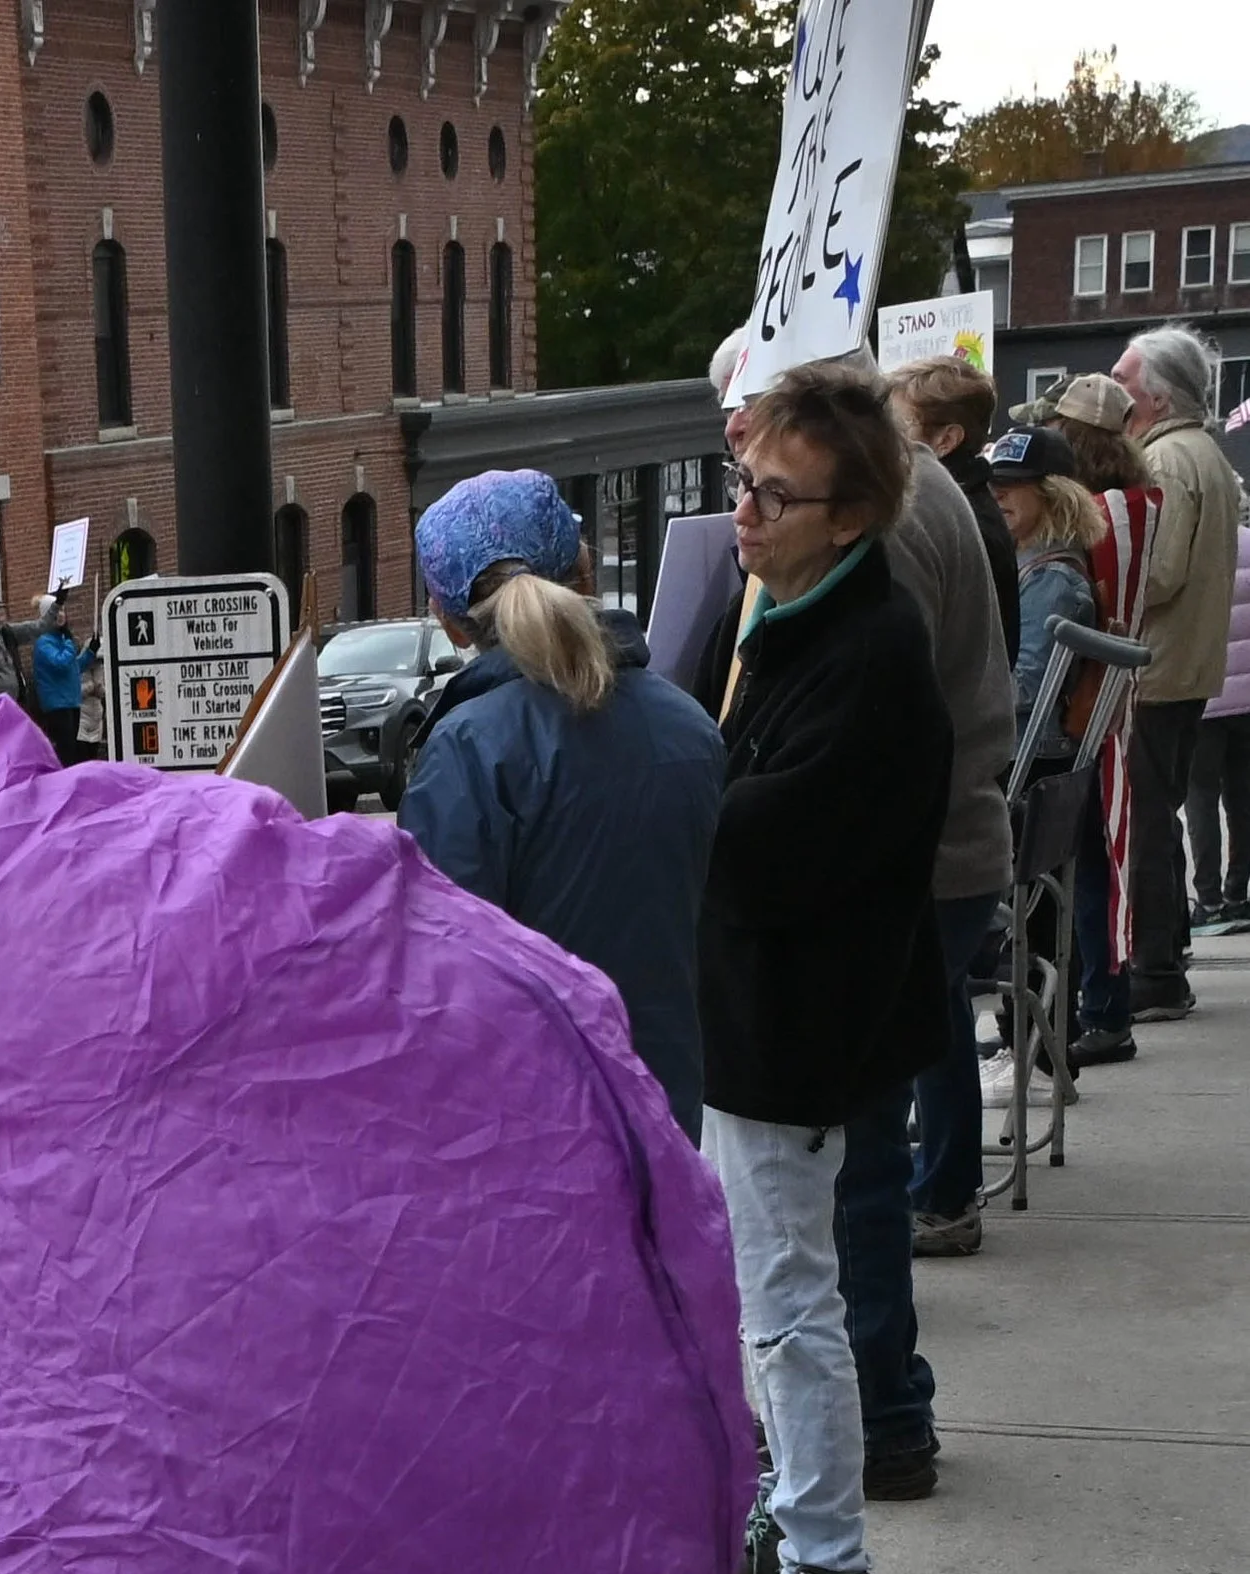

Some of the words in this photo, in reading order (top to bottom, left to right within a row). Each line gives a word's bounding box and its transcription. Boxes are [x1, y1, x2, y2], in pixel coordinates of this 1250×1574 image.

[787, 70, 843, 215] THE
[753, 158, 863, 342] PEOPLE
[897, 311, 936, 335] STAND
[166, 599, 199, 616] START
[204, 596, 258, 614] CROSSING
[186, 618, 217, 634] Watch
[223, 617, 239, 632] For
[193, 636, 234, 651] Vehicles
[180, 663, 212, 679] DON'T
[218, 661, 249, 677] START
[177, 684, 207, 699] Finish
[213, 682, 254, 699] Crossing
[206, 699, 241, 714] Started
[172, 726, 197, 742] TIME
[172, 745, 185, 759] To
[190, 744, 218, 759] Finish
